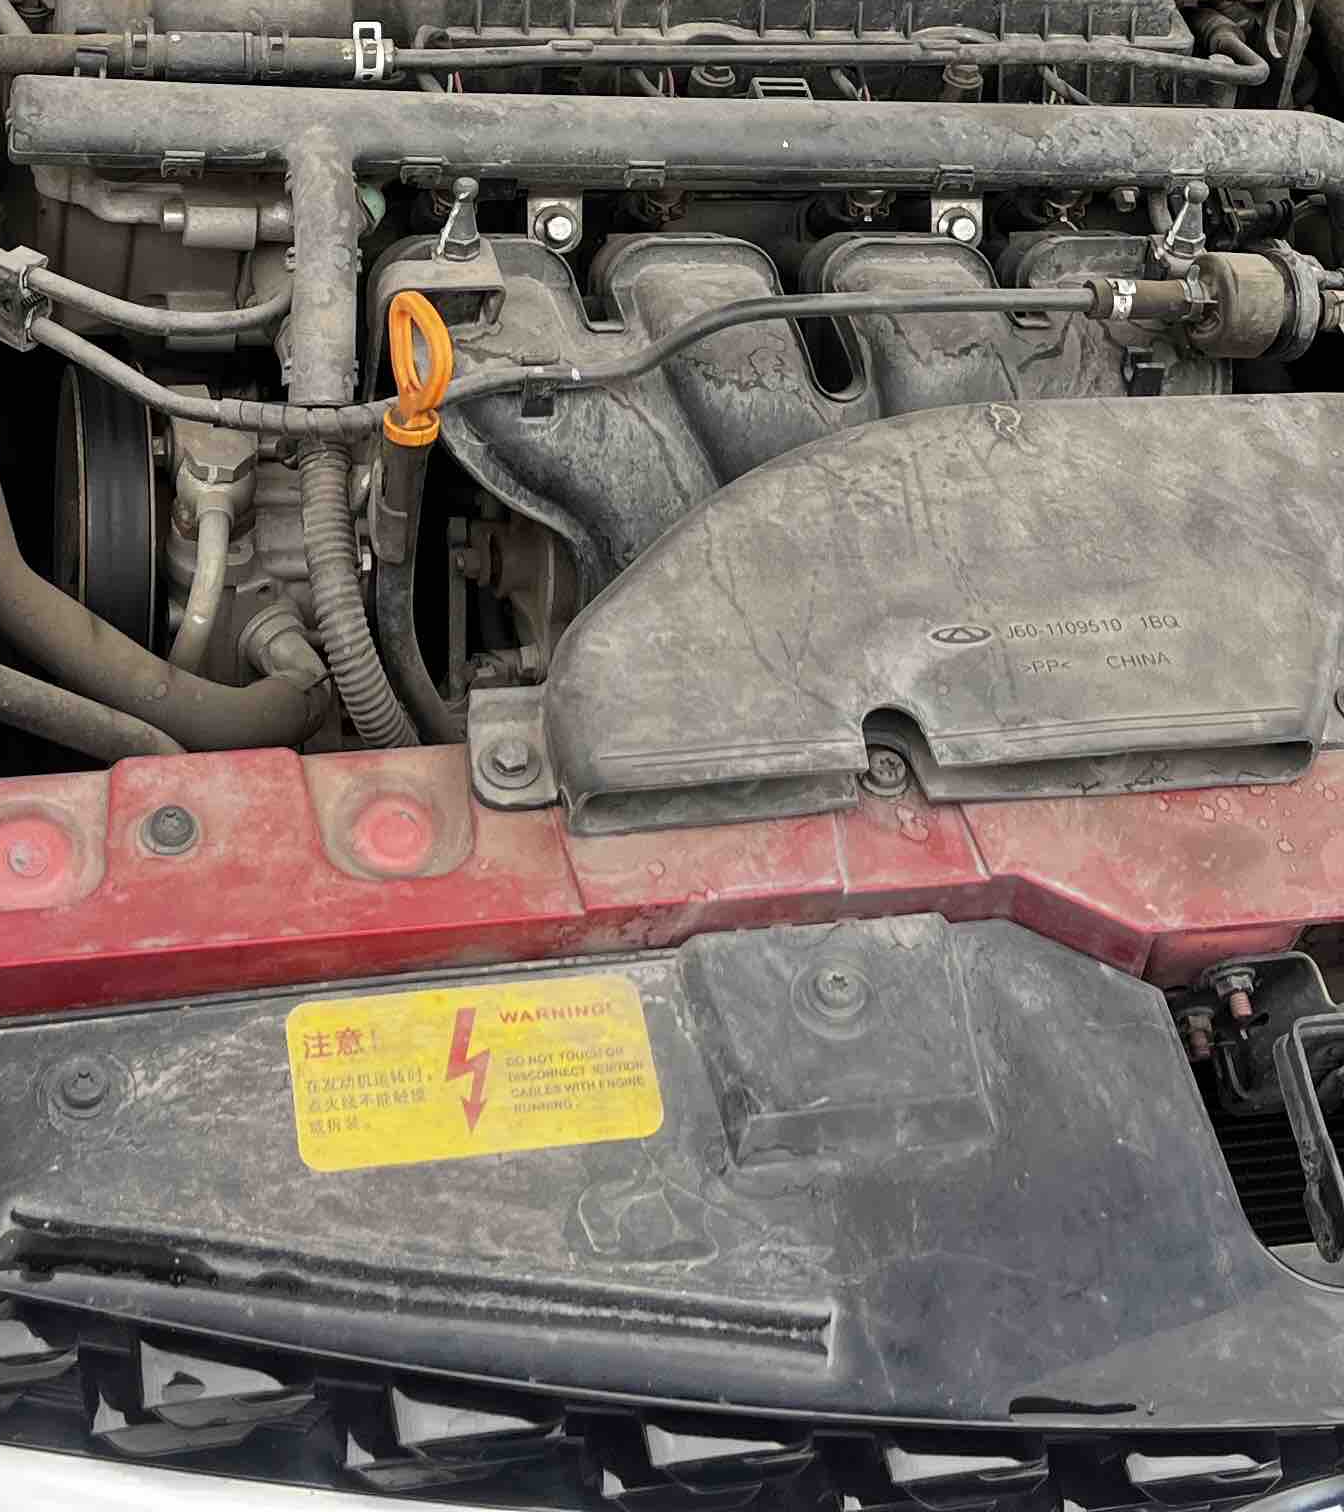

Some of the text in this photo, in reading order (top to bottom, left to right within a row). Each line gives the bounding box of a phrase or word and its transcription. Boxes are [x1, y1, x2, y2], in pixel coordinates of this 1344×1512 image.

[1106, 651, 1172, 671] CHINA
[498, 1001, 612, 1024] WARNING!
[528, 1053, 554, 1066] NOT
[564, 1079, 597, 1094] WITH
